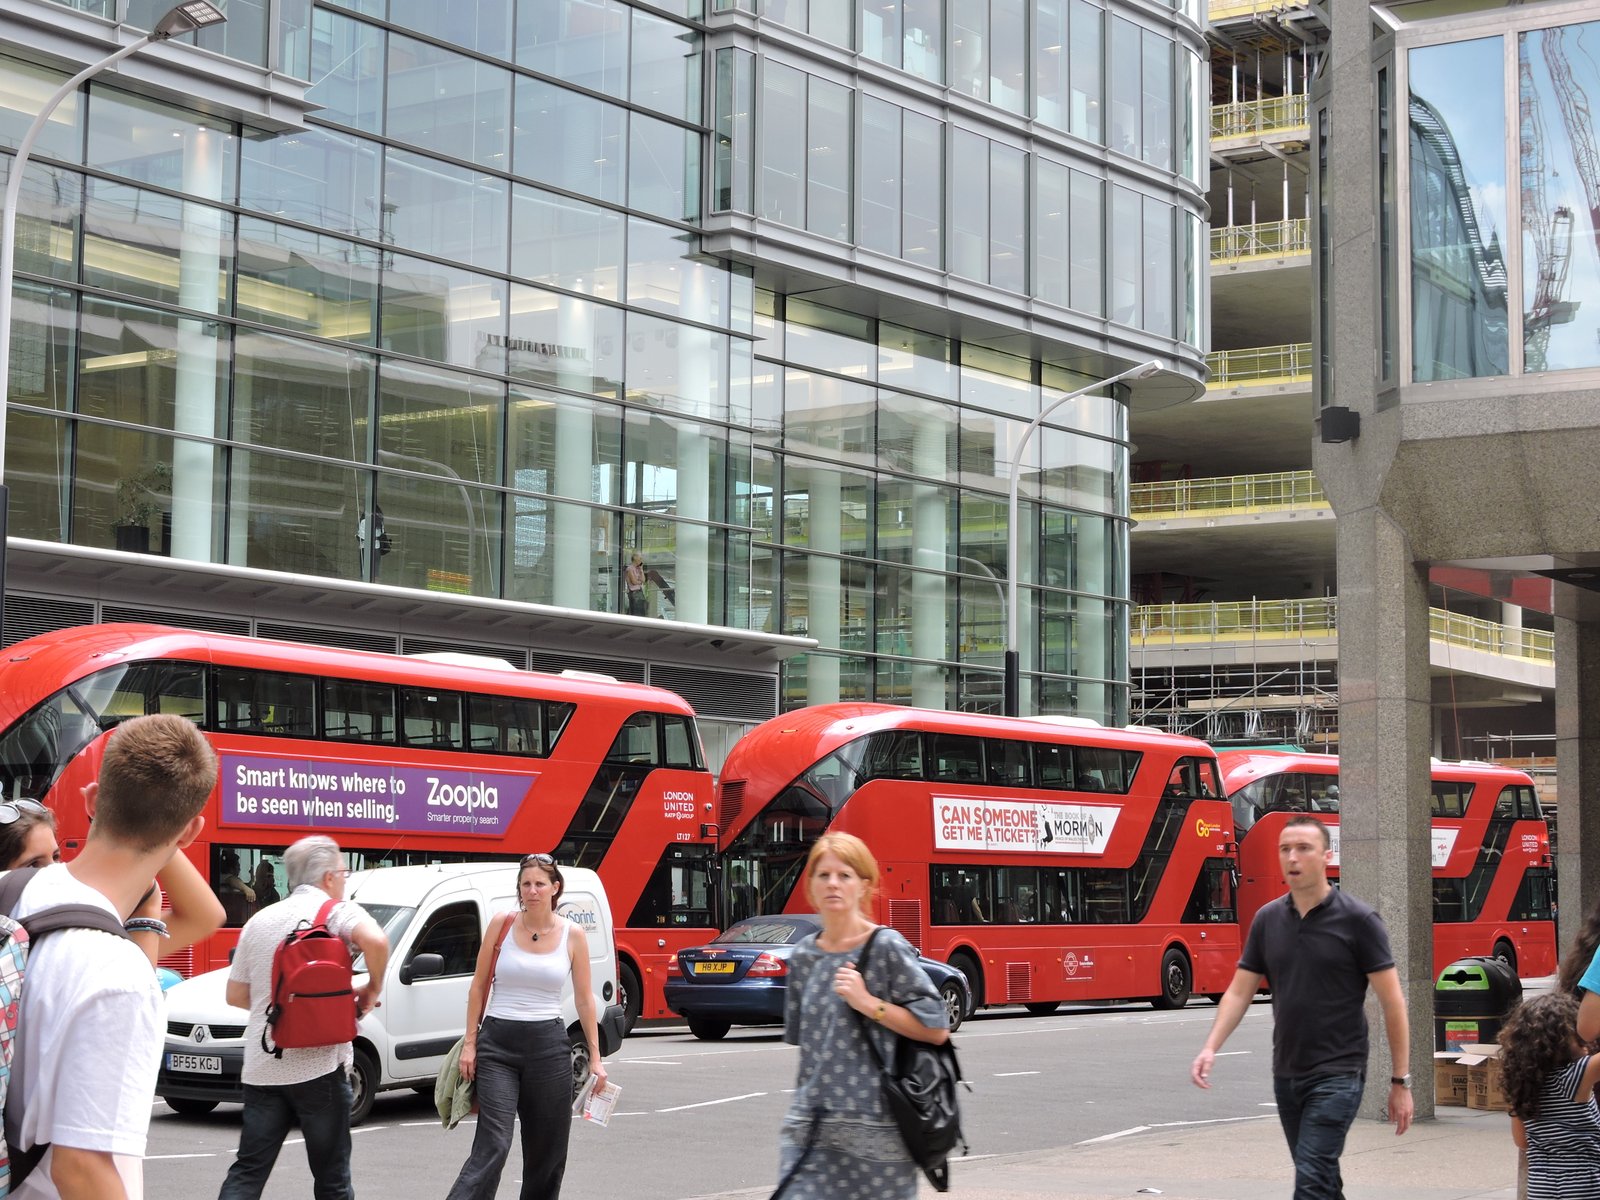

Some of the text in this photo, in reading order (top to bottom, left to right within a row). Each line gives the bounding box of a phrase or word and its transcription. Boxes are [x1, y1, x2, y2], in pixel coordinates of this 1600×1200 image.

[236, 764, 406, 795] Smart knows where to
[426, 777, 499, 813] Zoopla
[663, 791, 694, 801] LONDON
[237, 791, 400, 824] be seen when selling.
[663, 802, 695, 812] UNITED
[1054, 811, 1063, 819] THE
[1064, 812, 1080, 820] BOOK
[427, 811, 500, 826] Smarter property search
[973, 806, 1039, 829] SOMEONE
[942, 825, 965, 841] GET
[967, 827, 983, 841] ME
[985, 827, 994, 842] A
[1054, 820, 1104, 837] MORMON
[173, 1055, 219, 1071] BF55 KGJ
